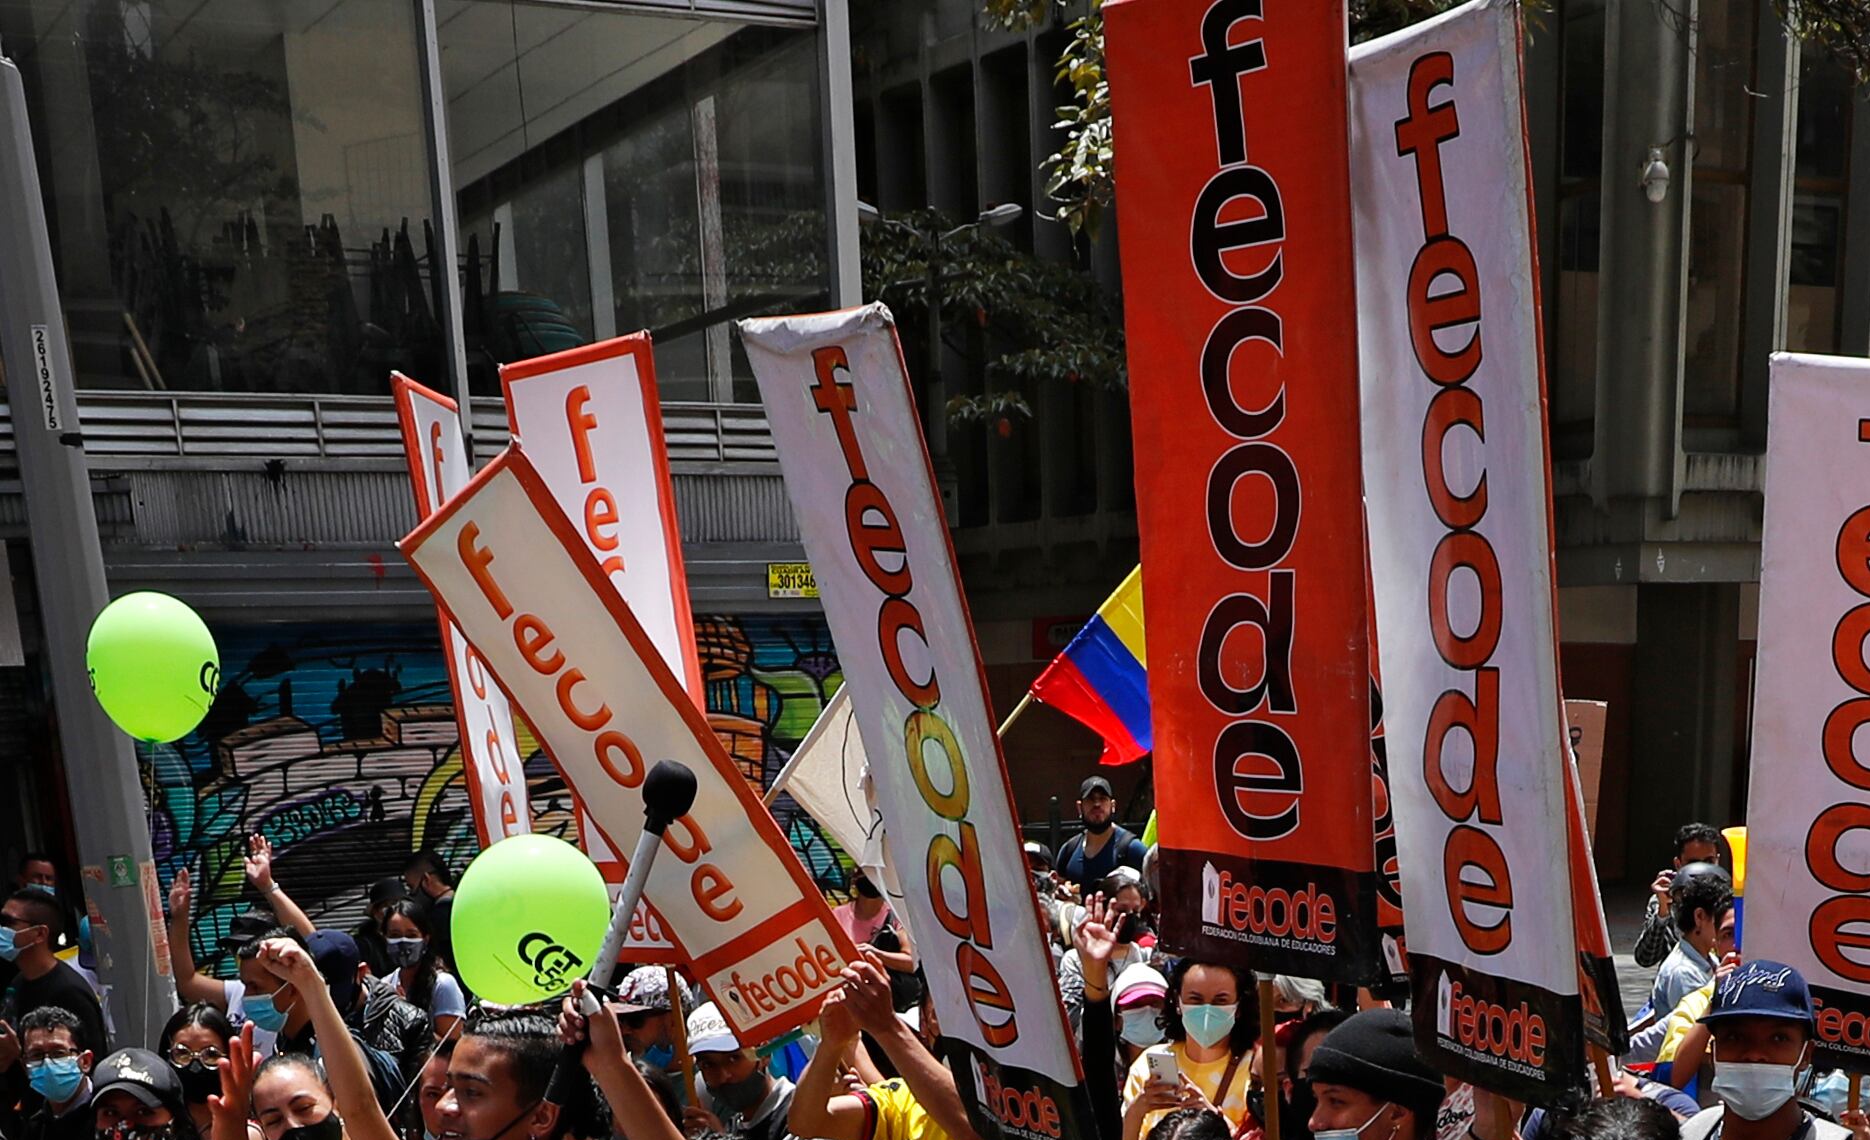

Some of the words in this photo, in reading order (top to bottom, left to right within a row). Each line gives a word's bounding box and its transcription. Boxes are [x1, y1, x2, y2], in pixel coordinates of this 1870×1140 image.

[35, 330, 57, 429] 26192475
[1189, 0, 1304, 842] fecode
[1394, 51, 1514, 955] fecode
[778, 574, 816, 589] 301346
[810, 346, 1016, 1048] fecode
[1218, 870, 1336, 944] fecode
[1238, 932, 1280, 947] COLOMBIANA
[1281, 938, 1290, 948] DE
[1291, 939, 1336, 956] EDUCADORES
[731, 935, 842, 1018] fecode
[1450, 981, 1546, 1068] fecode
